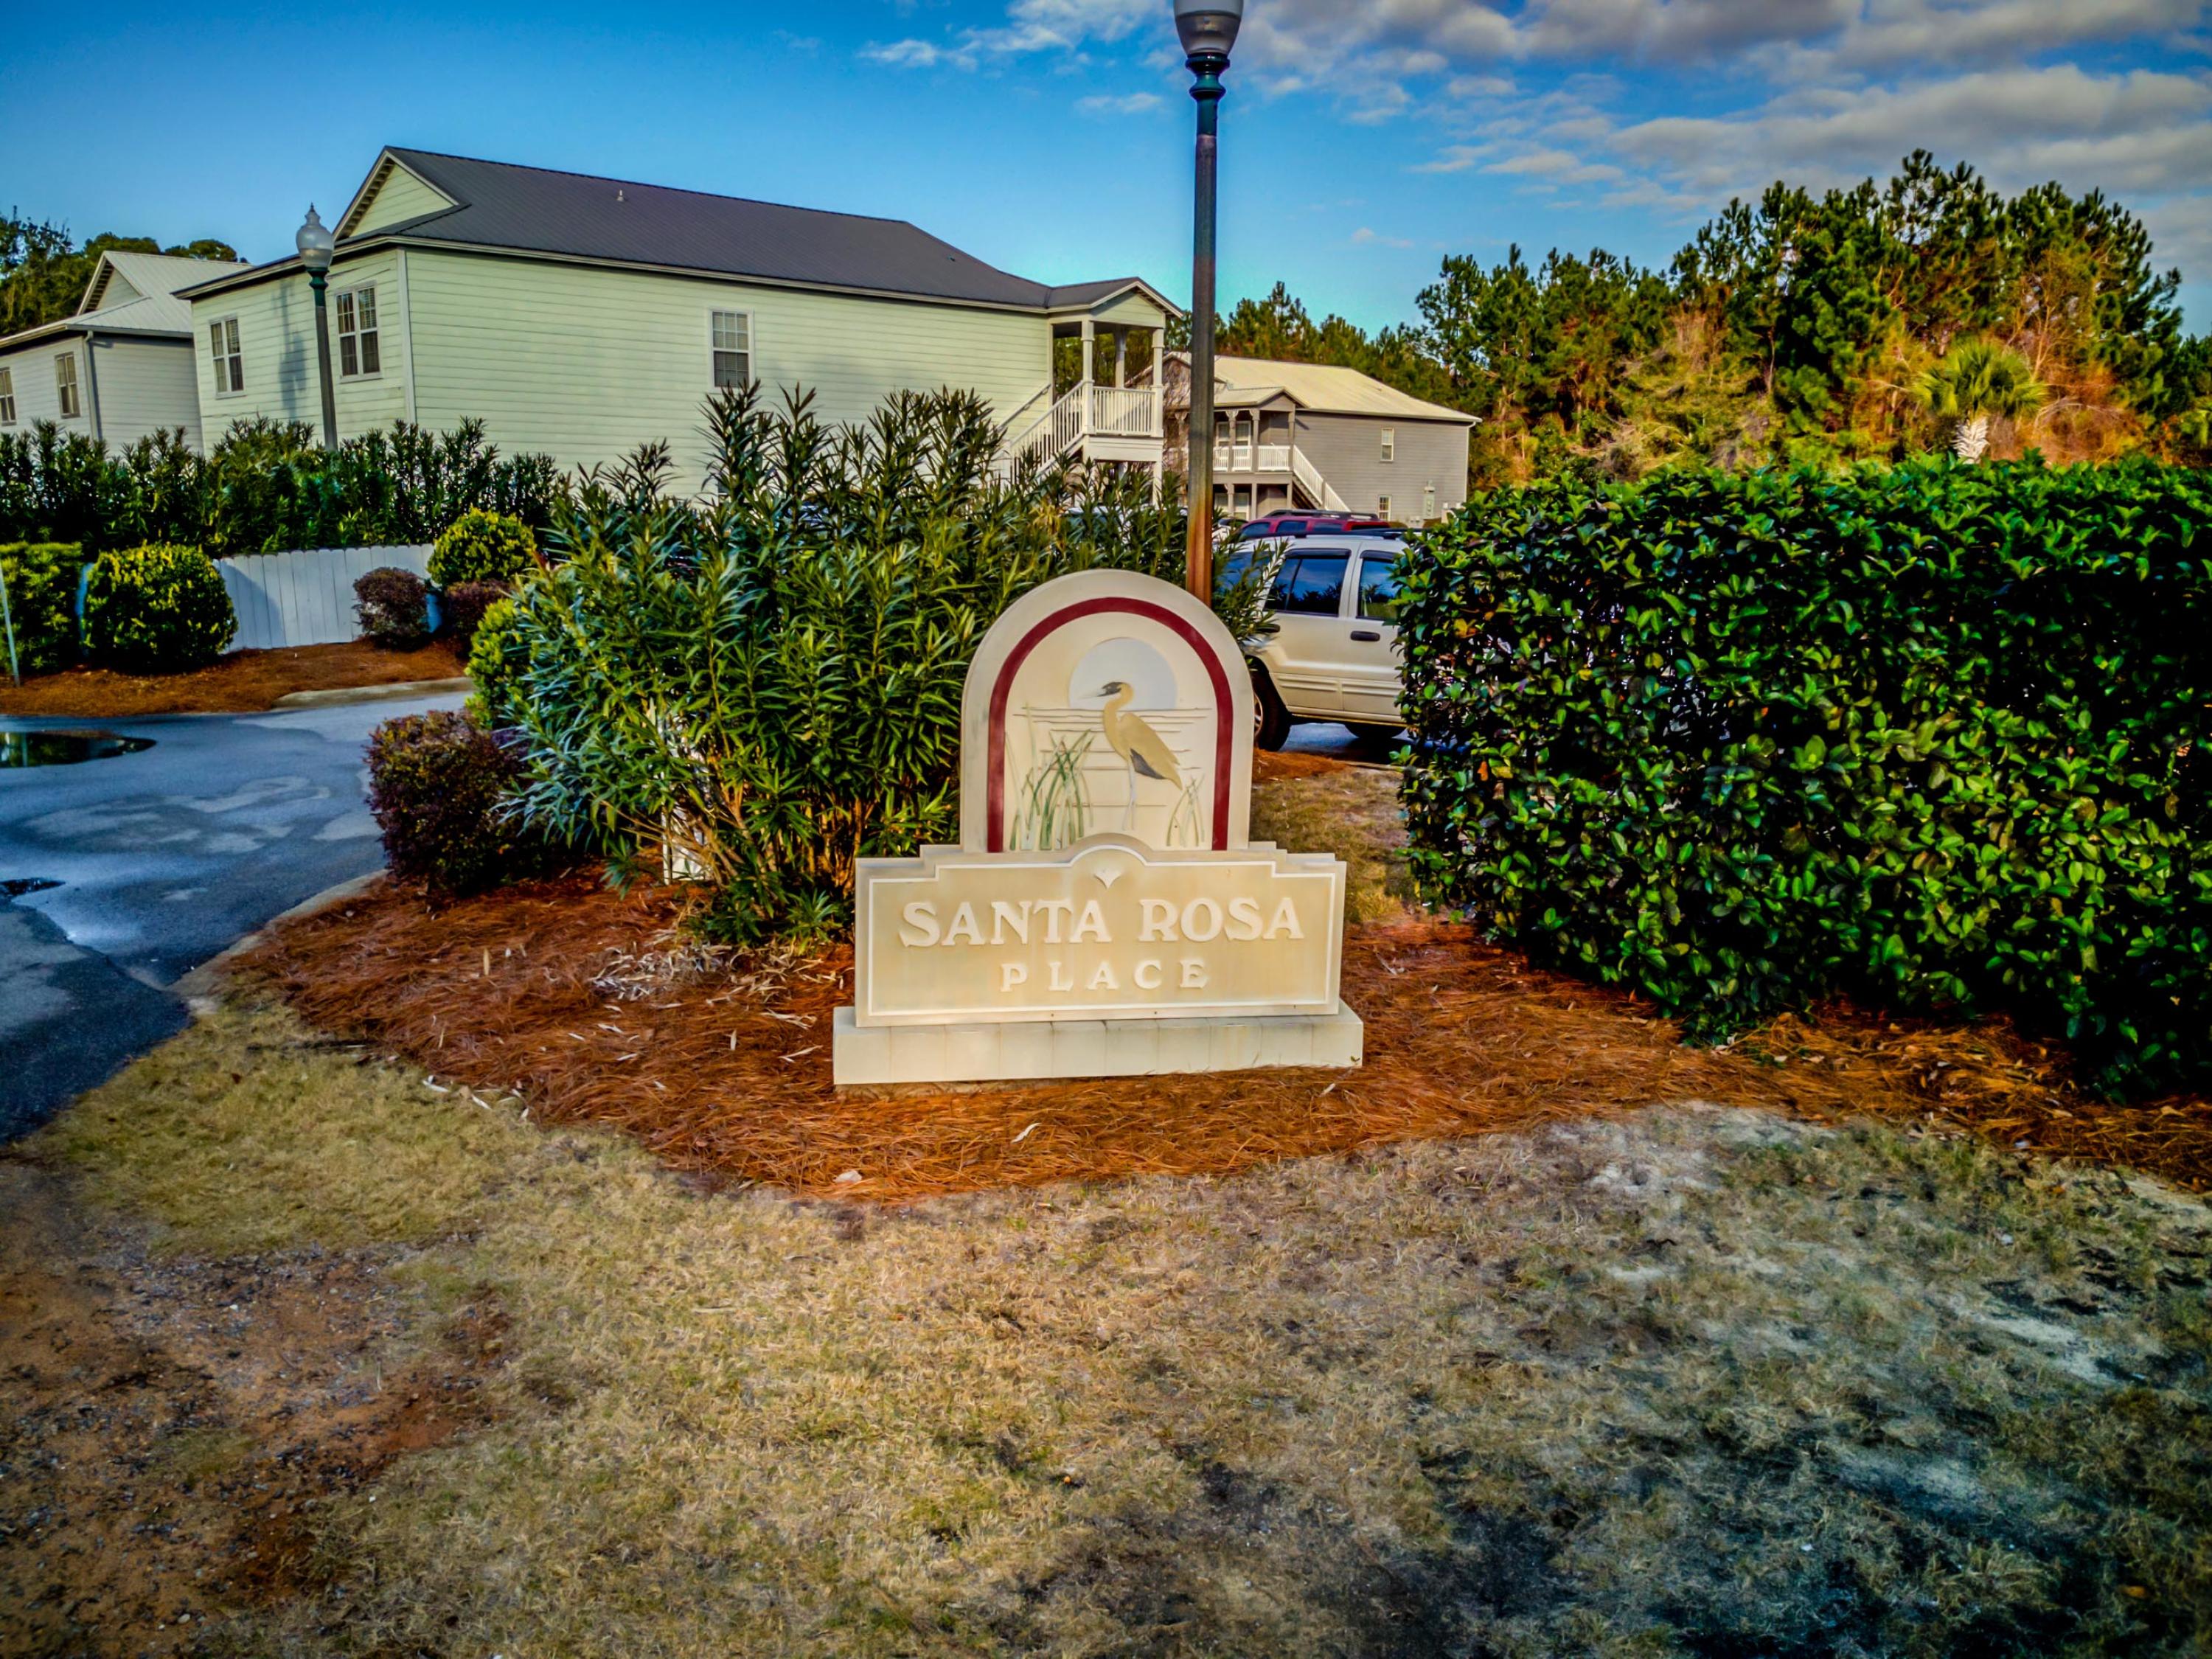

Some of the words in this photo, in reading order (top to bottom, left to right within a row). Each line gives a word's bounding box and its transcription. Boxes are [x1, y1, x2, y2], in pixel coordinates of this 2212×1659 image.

[899, 899, 1111, 947] SANTA
[1138, 897, 1304, 943] ROSA
[1001, 959, 1209, 992] PLACE
